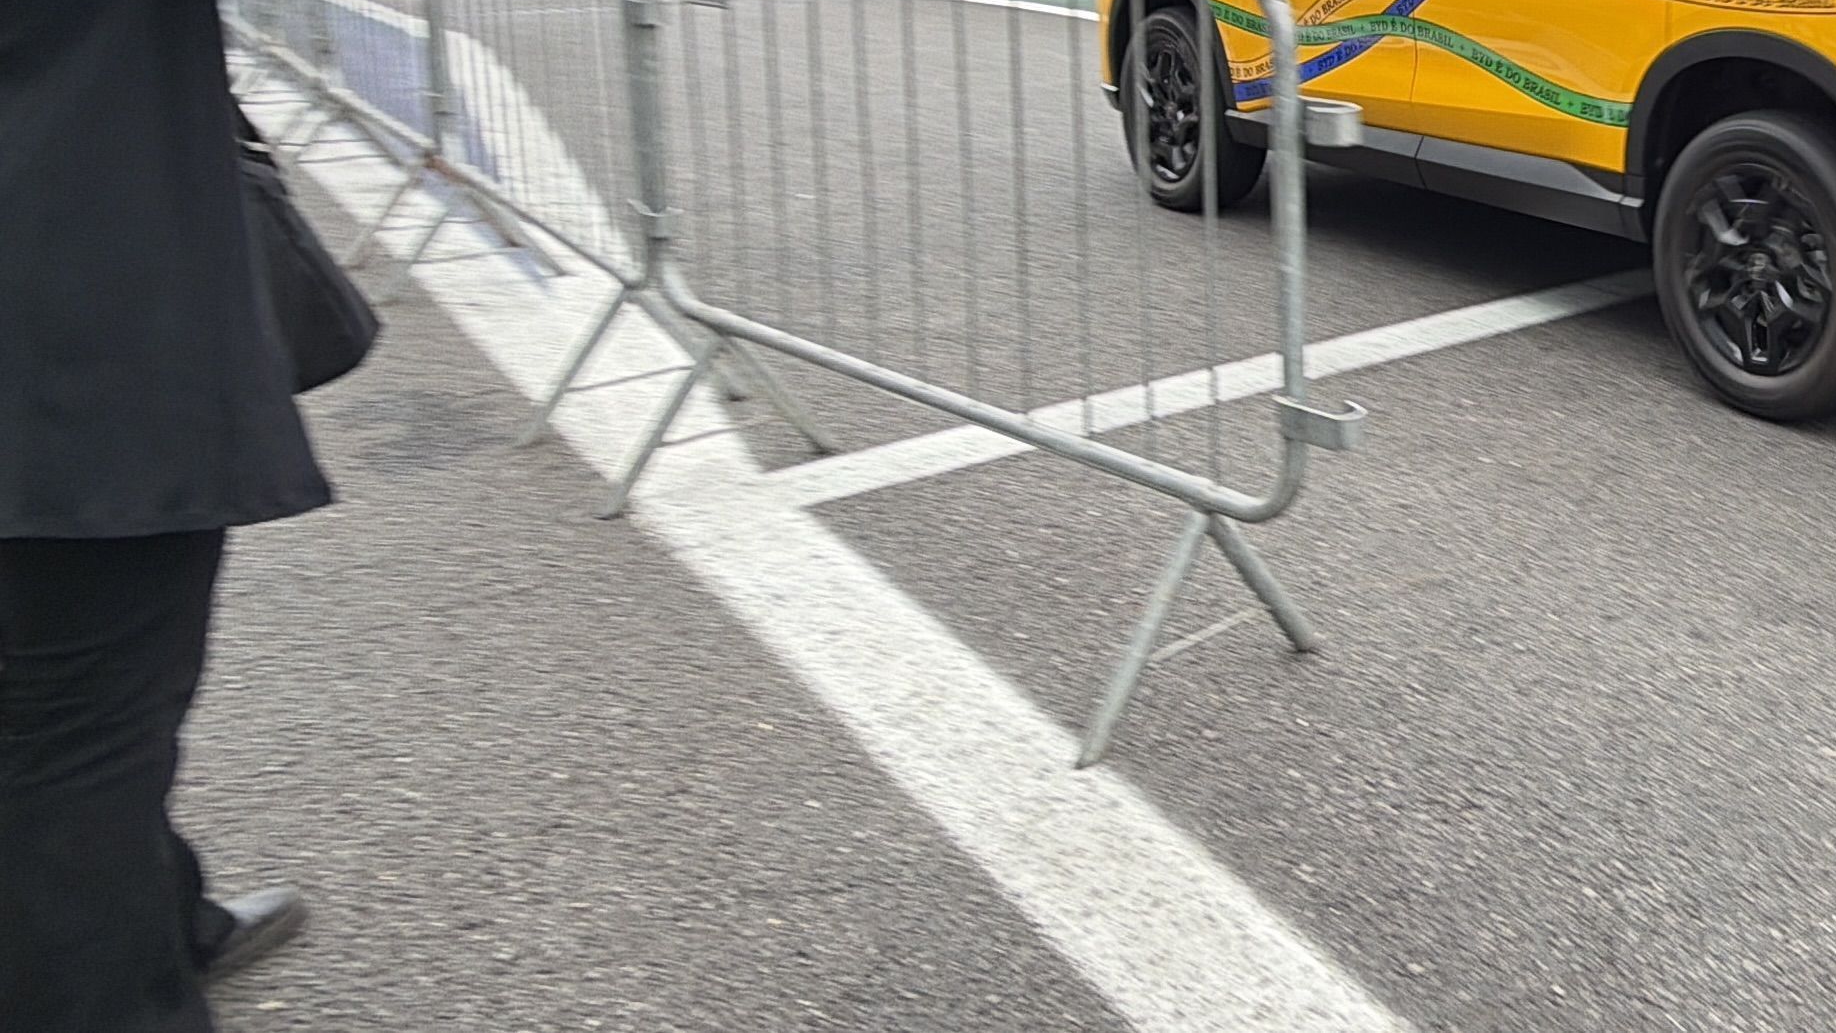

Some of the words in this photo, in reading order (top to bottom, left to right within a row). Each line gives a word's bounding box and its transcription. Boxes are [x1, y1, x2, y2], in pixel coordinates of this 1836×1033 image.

[1310, 9, 1321, 24] DO
[1370, 20, 1388, 32] BYD
[1391, 17, 1397, 32] É
[1401, 20, 1415, 35] DO
[1418, 27, 1454, 49] BRASIL
[1471, 48, 1493, 68] BYD
[1506, 67, 1521, 84] DO
[1522, 81, 1561, 106] BRASIL
